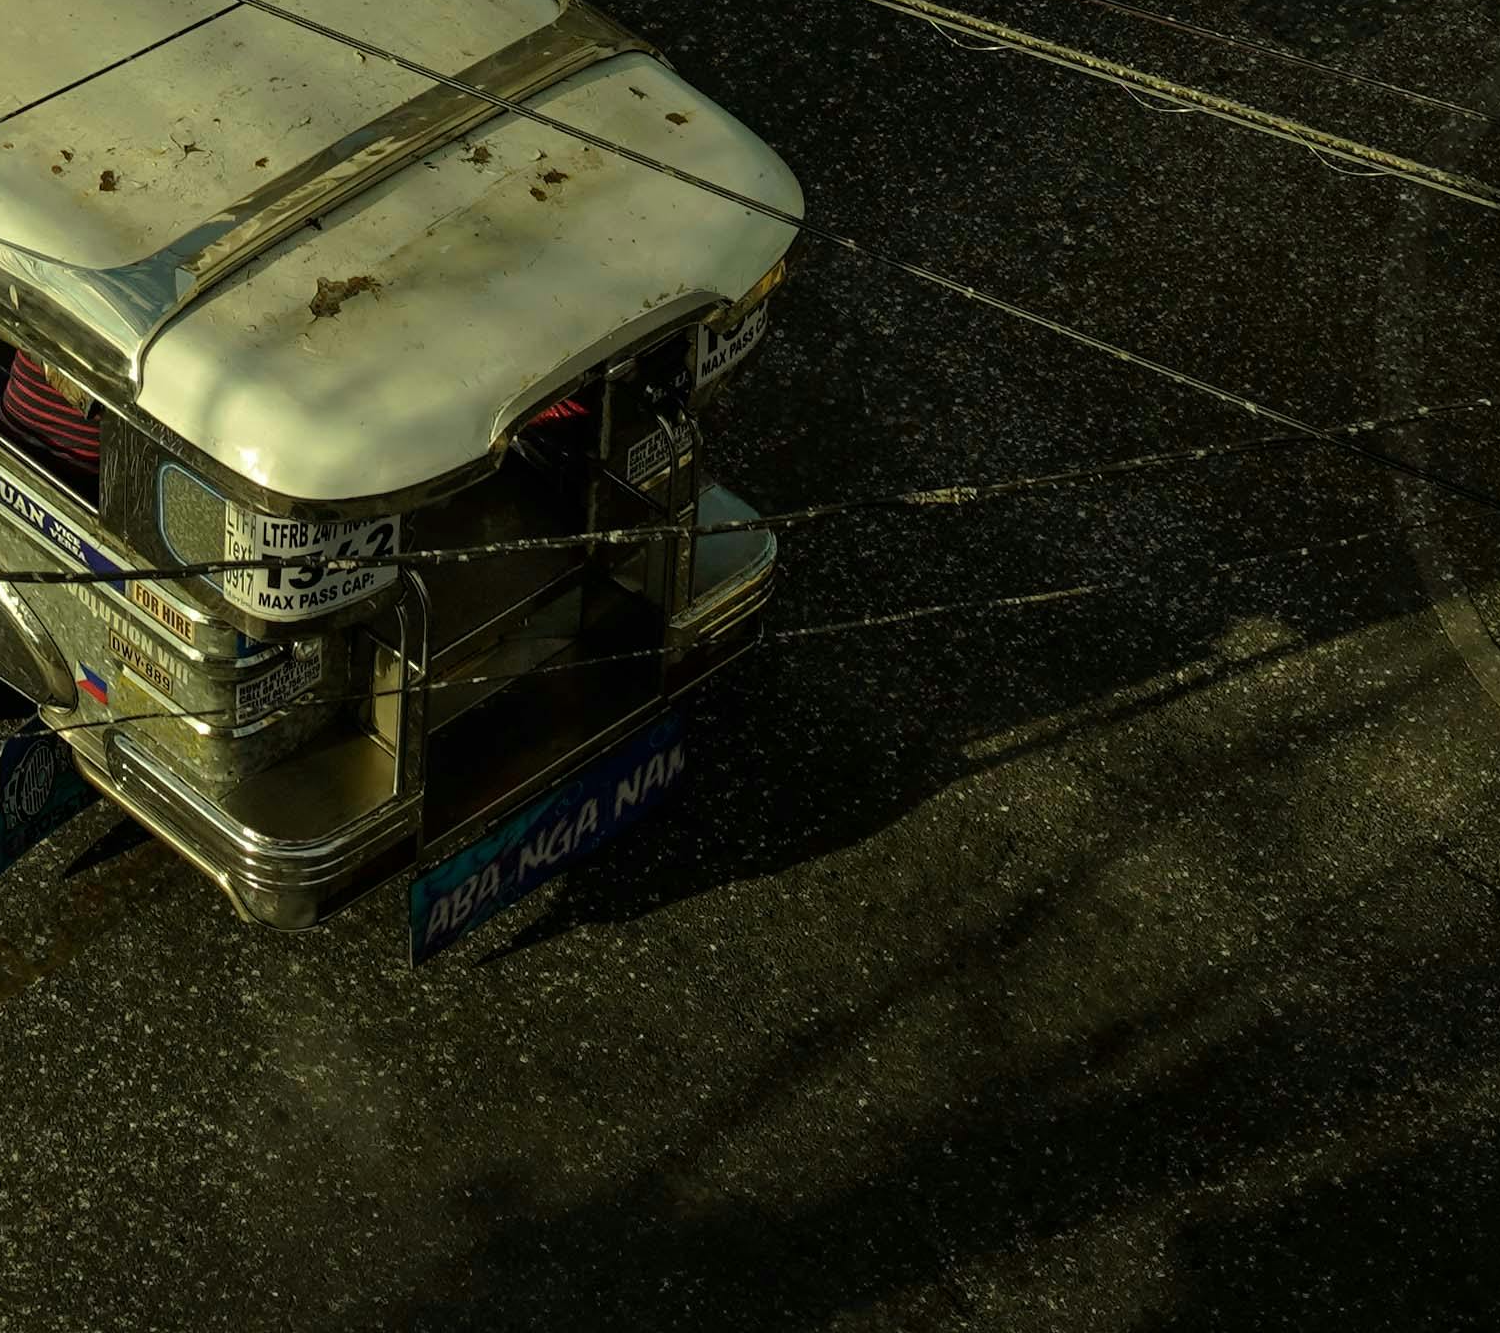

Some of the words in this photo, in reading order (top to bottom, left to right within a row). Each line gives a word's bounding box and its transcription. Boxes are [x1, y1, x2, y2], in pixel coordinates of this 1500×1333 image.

[702, 349, 727, 377] MAX
[730, 327, 754, 359] PASS
[263, 522, 309, 549] LTFRB
[136, 583, 159, 616] FOR
[162, 604, 192, 641] HIRE
[259, 592, 295, 610] MAX
[300, 588, 338, 608] PASS
[342, 573, 375, 596] CAP:
[426, 865, 500, 946] ABA
[517, 797, 598, 883] NGA
